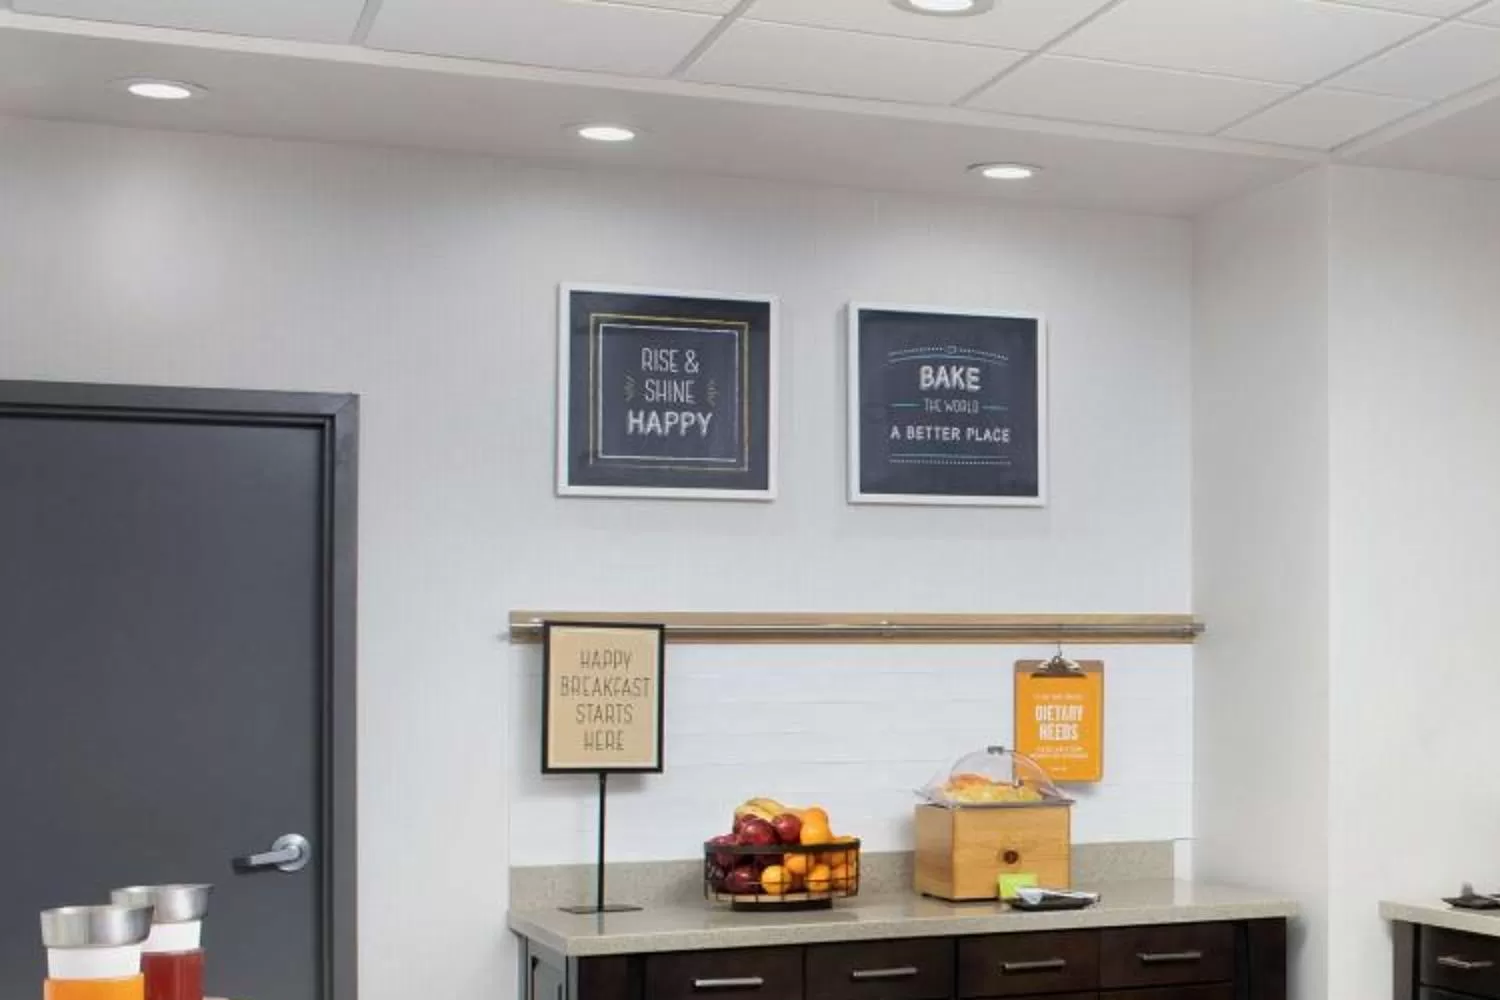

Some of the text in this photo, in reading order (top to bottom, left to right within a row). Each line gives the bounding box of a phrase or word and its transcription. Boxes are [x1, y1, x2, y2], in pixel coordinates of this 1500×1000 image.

[641, 347, 700, 373] RISE &
[919, 365, 981, 391] BAKE
[644, 378, 697, 404] SHINE
[924, 398, 980, 414] THE WORLD
[626, 409, 713, 437] HAPPY
[890, 425, 1010, 443] A BETTER PLACE
[580, 649, 633, 670] HAPPY
[560, 675, 652, 697] BREAKFAST
[576, 703, 634, 725] STARTS
[1035, 704, 1083, 721] DIETARY
[583, 730, 625, 752] HERE
[1039, 723, 1079, 741] NEEDS
